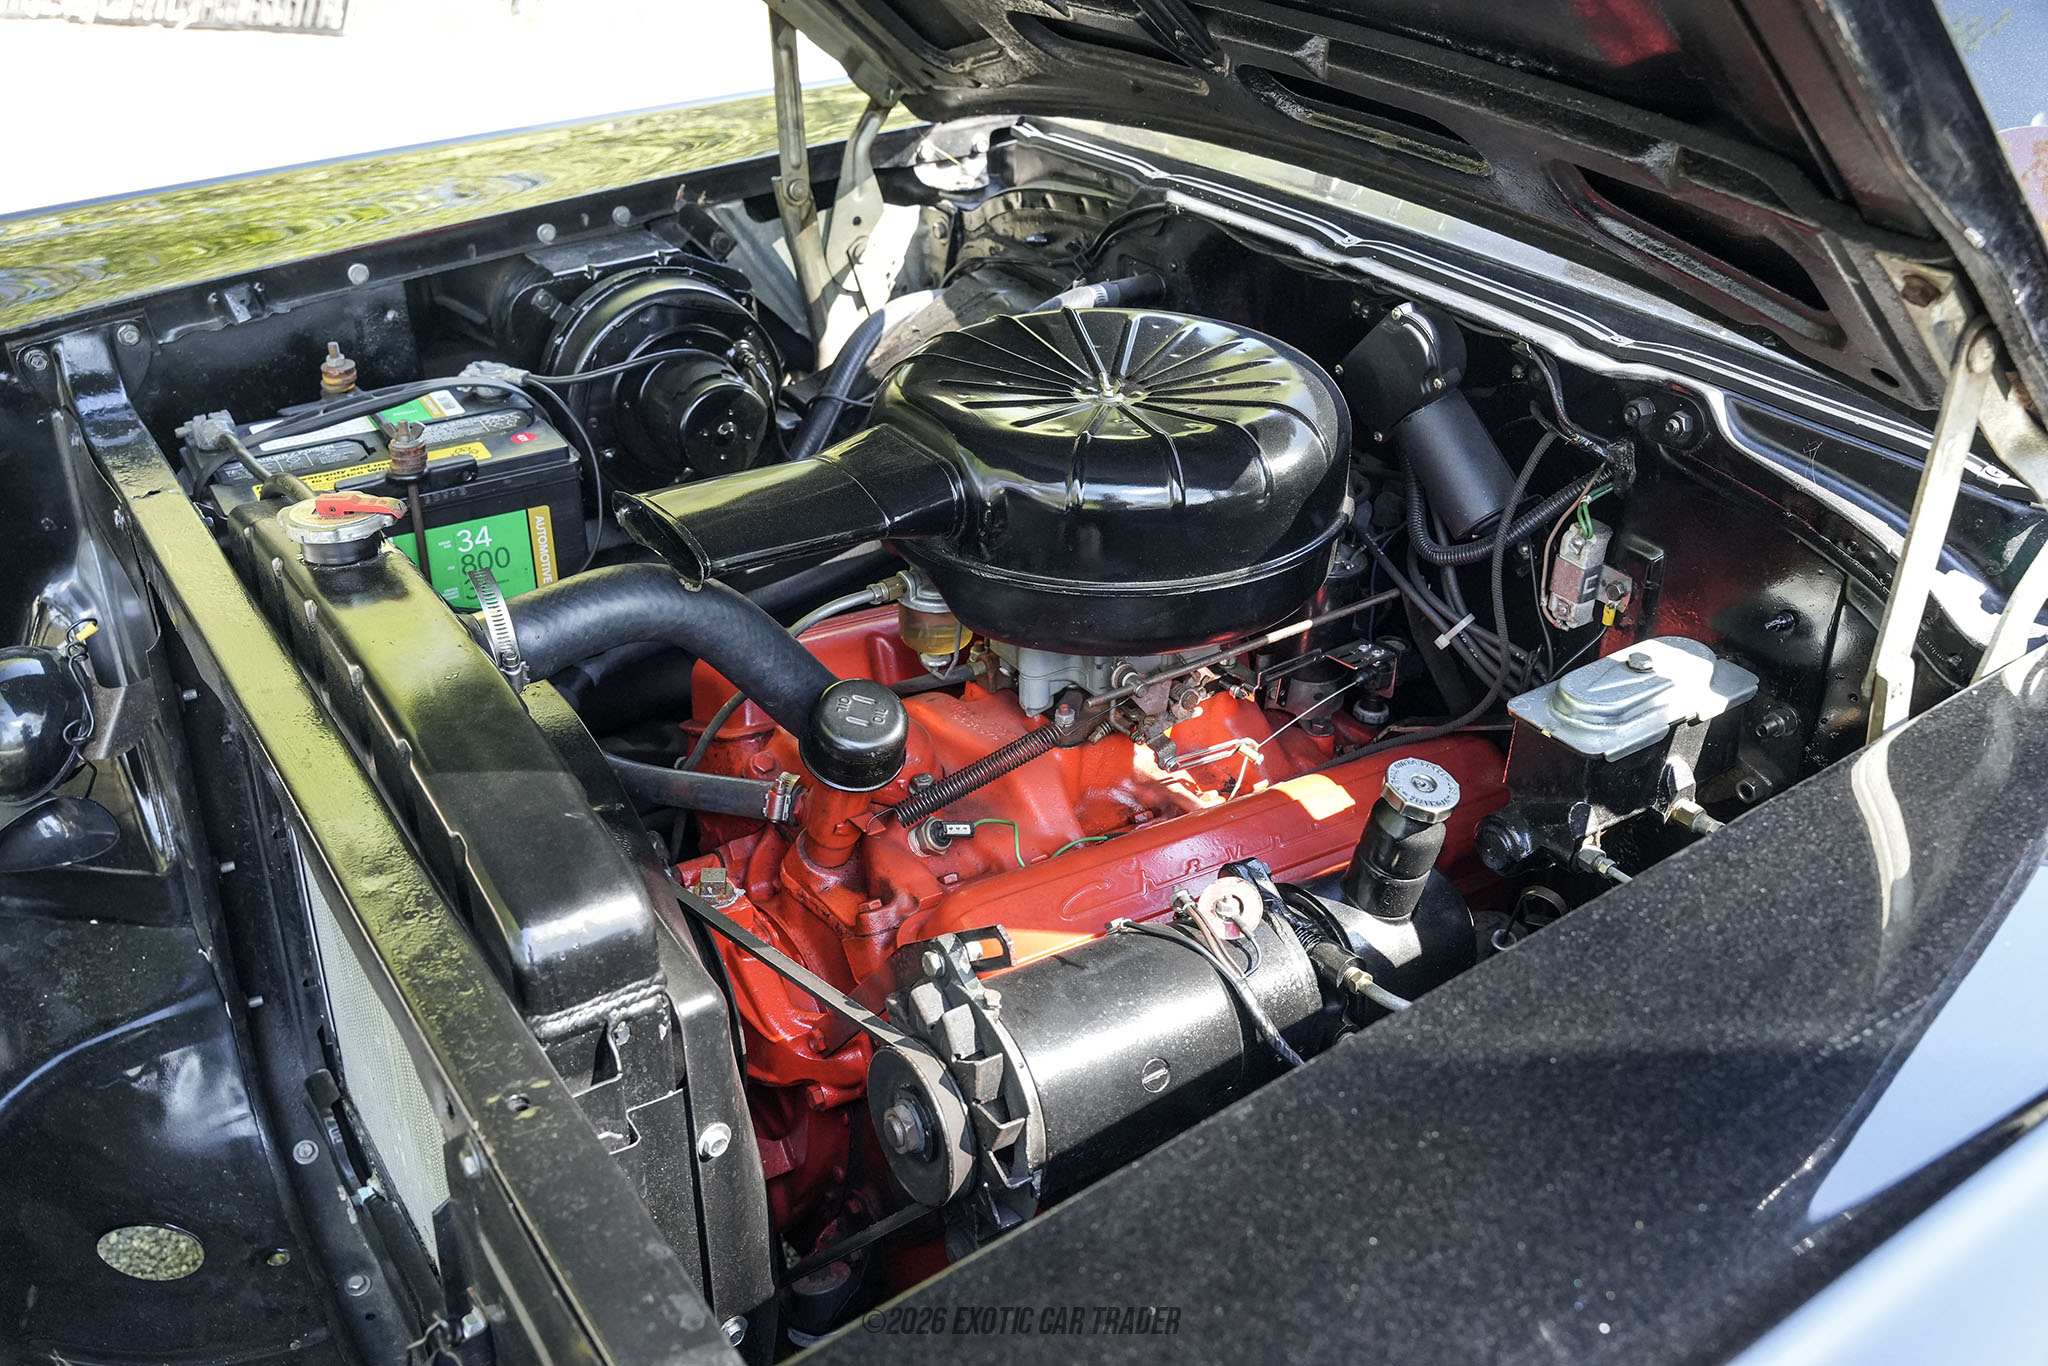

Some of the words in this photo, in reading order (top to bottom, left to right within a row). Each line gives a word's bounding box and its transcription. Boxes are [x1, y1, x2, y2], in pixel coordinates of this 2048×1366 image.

[326, 471, 364, 481] Costco
[456, 525, 492, 552] 34
[534, 515, 553, 585] AUTOMOTIVE
[461, 546, 510, 577] 800
[836, 696, 852, 713] OIL
[872, 708, 889, 725] OIL
